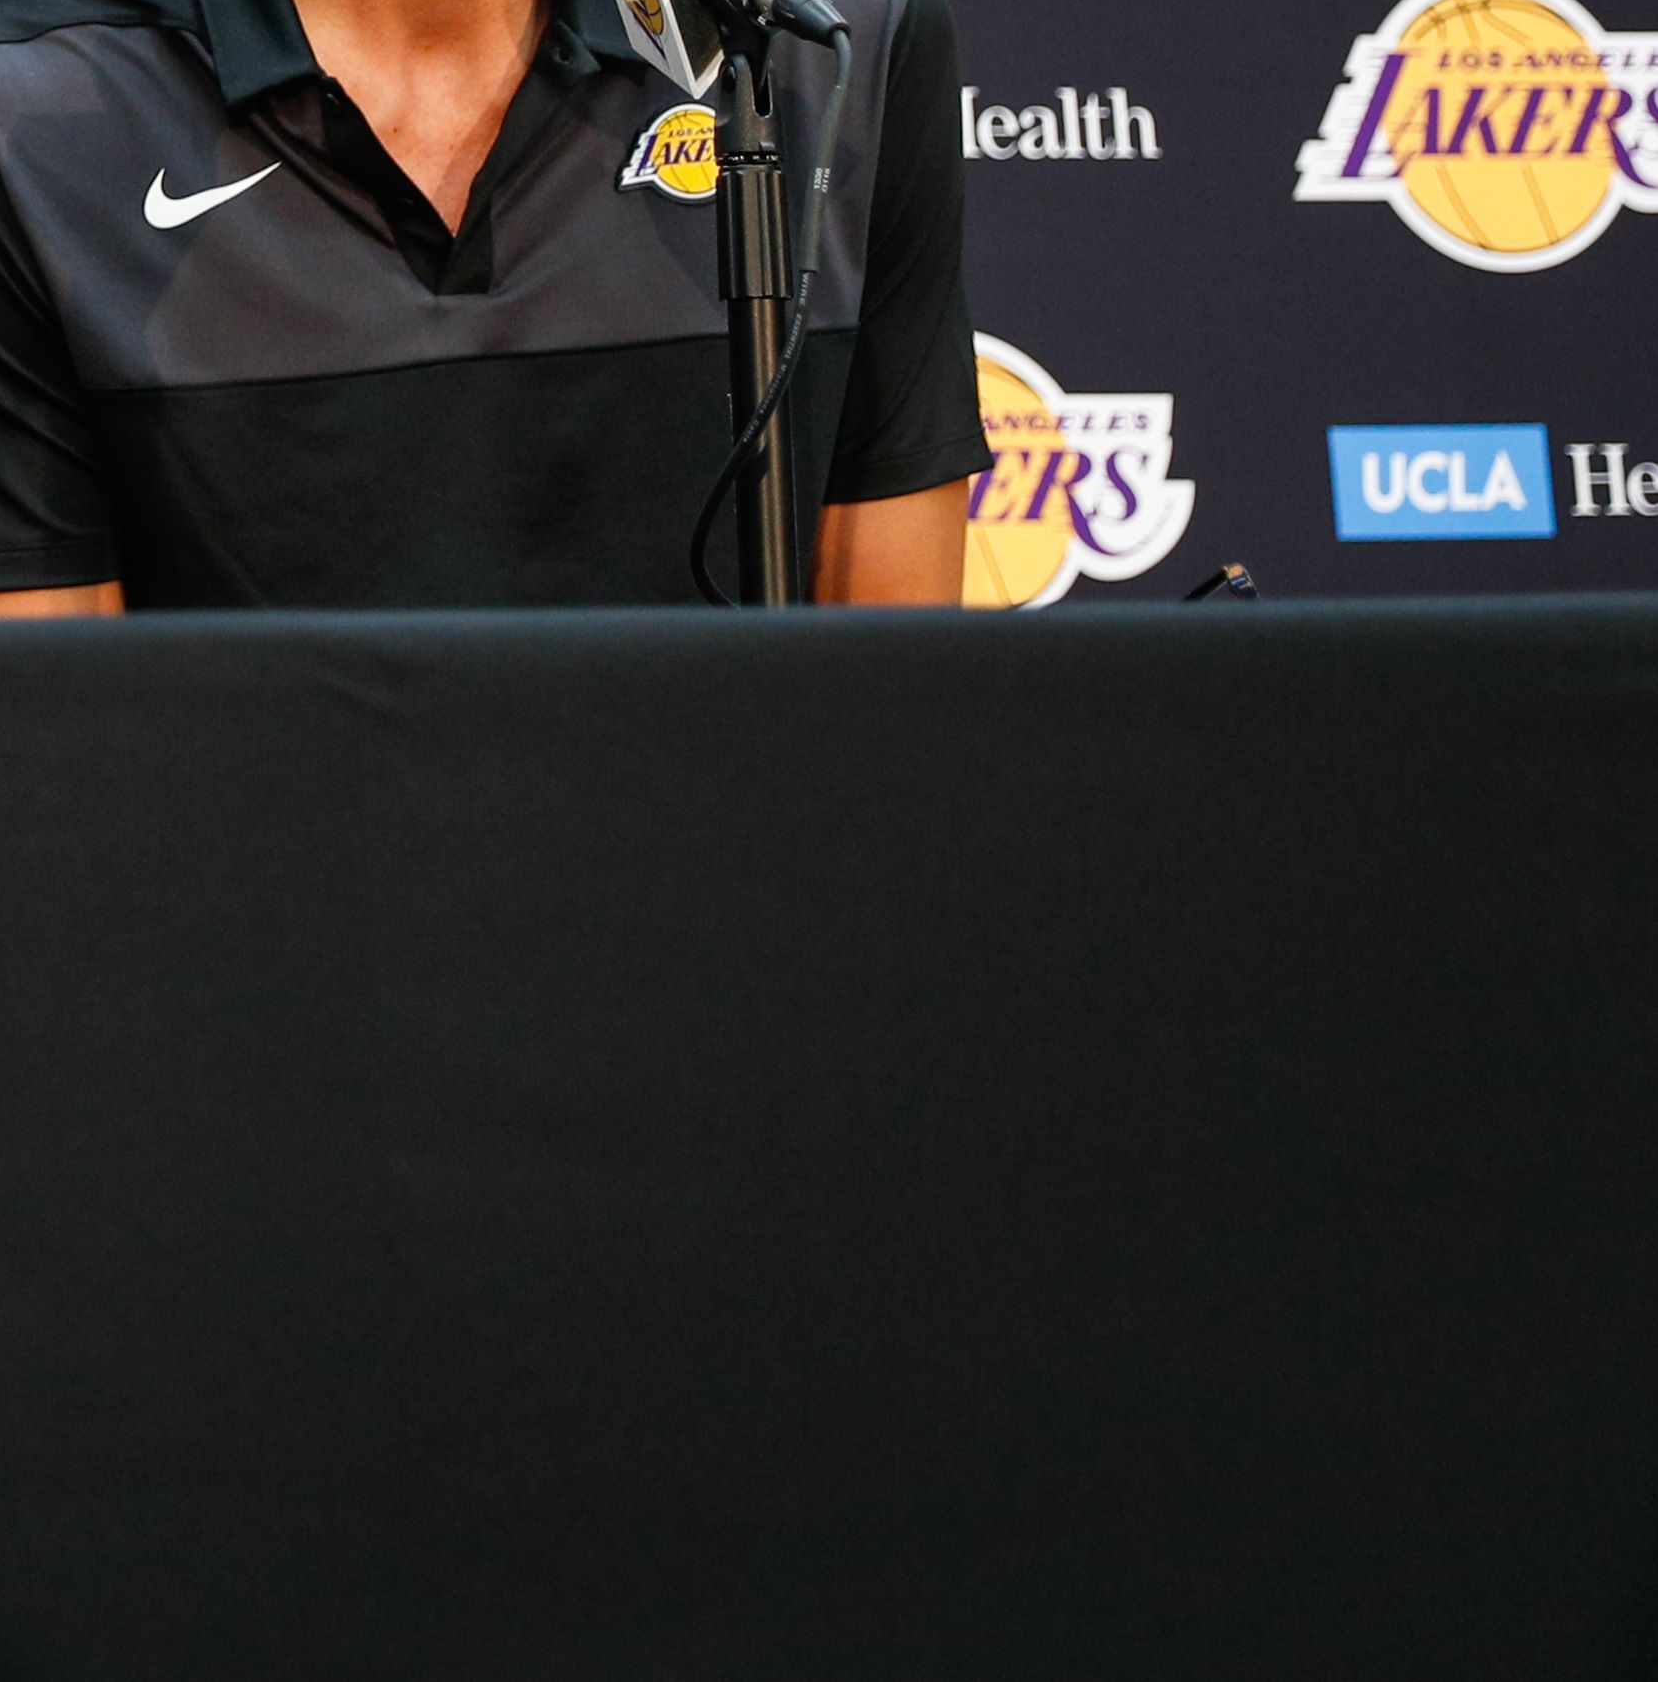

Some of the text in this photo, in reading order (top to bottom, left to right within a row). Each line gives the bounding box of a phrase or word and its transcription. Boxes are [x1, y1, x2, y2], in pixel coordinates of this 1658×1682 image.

[1438, 49, 1658, 70] LOS ANGEL
[636, 134, 714, 177] LAKE
[968, 448, 1152, 556] ERS
[1362, 450, 1528, 514] UCLA
